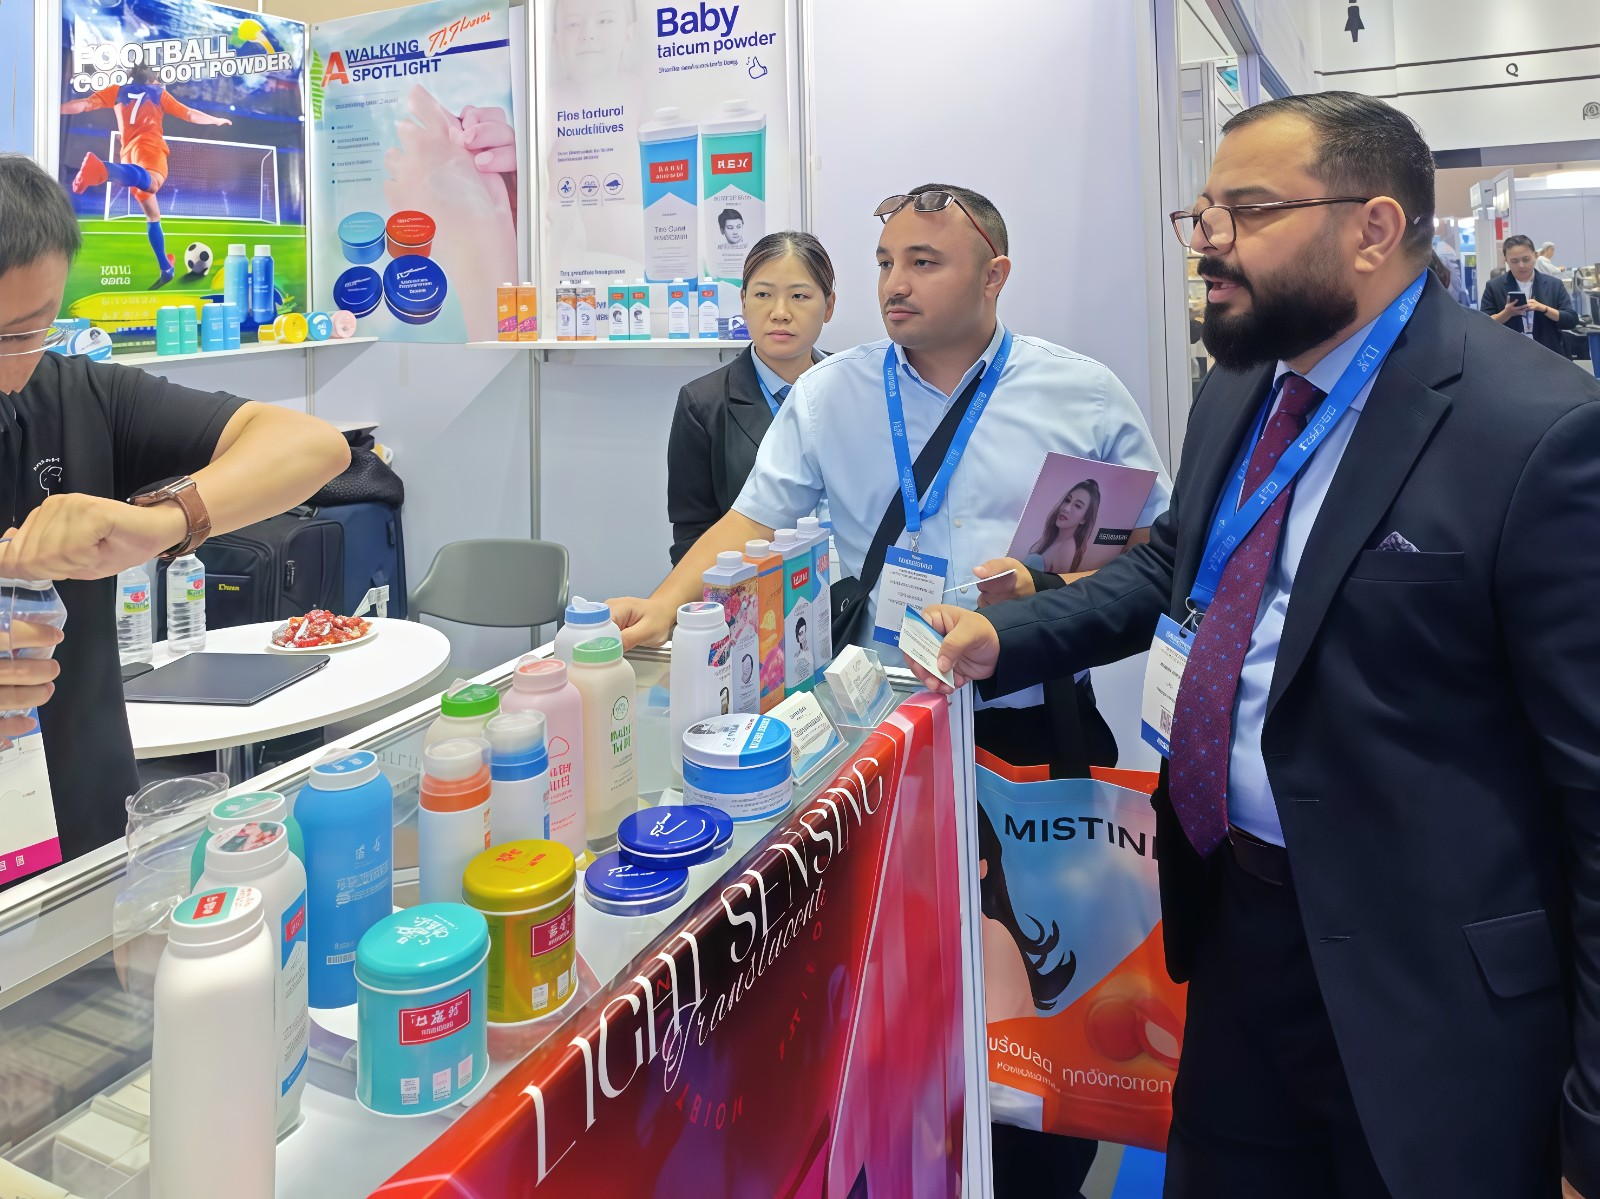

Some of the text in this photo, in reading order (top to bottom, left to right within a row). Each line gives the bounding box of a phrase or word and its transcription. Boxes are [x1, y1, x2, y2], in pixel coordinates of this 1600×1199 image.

[657, 2, 739, 37] Baby
[74, 36, 236, 73] FOOTBALL
[714, 31, 777, 54] powder
[321, 40, 419, 87] A WALKING
[352, 59, 441, 82] SPOTLIGHT
[128, 92, 145, 124] 7
[1004, 813, 1157, 860] MISTIN
